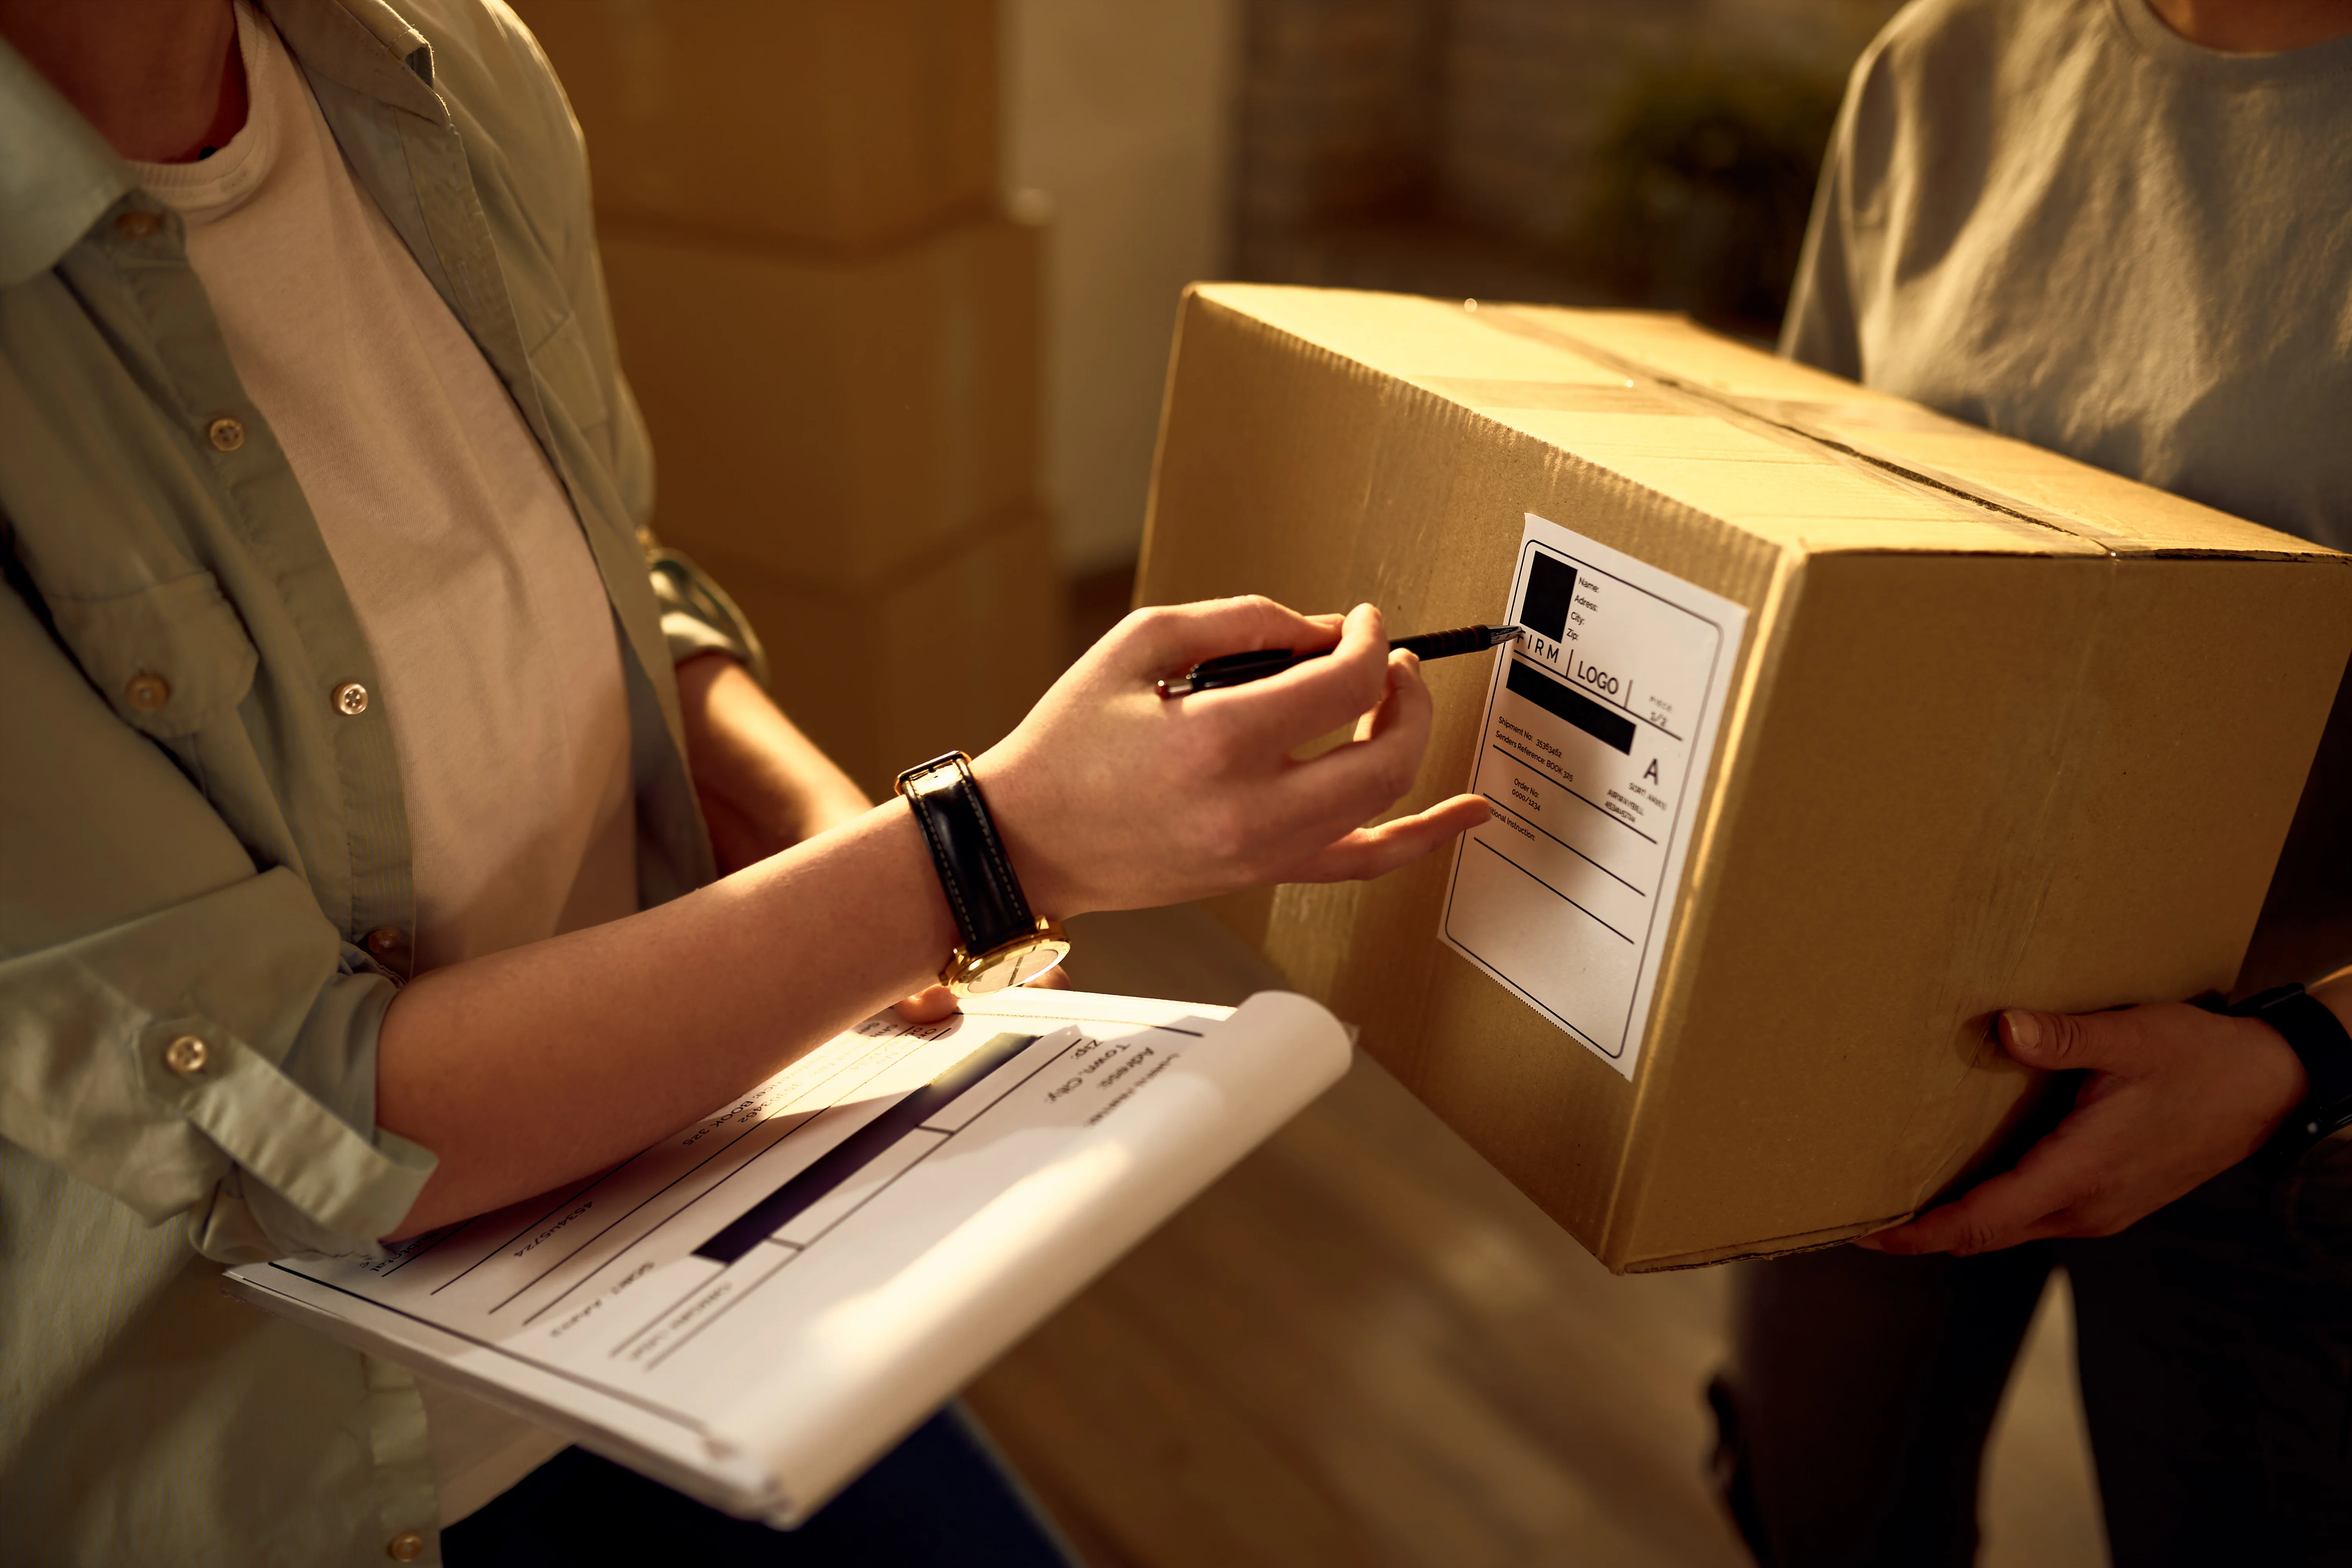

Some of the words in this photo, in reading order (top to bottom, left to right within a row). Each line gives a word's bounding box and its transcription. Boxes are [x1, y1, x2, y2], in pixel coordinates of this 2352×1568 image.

[1578, 577, 1600, 593] Name:
[1574, 595, 1599, 612] Adress:
[1571, 612, 1585, 626] City:
[1566, 628, 1579, 641] Zip:
[1517, 630, 1559, 663] FIRM
[1577, 661, 1619, 695] LOGO
[1498, 716, 1523, 736] Shipment
[1524, 730, 1533, 741] No:
[1536, 739, 1562, 758] 35363462
[1495, 730, 1517, 748] Senders
[1517, 743, 1545, 765] Reference:
[1546, 760, 1563, 775] BOOK
[1563, 771, 1573, 782] 325
[1642, 758, 1659, 785] A
[1514, 778, 1529, 792] Order
[1530, 788, 1539, 798] No:
[1512, 789, 1541, 811] 0000/1234
[1490, 806, 1506, 822] itional
[1507, 817, 1535, 841] Instruction:
[710, 1100, 754, 1127] BOOK
[682, 1128, 710, 1145] 325
